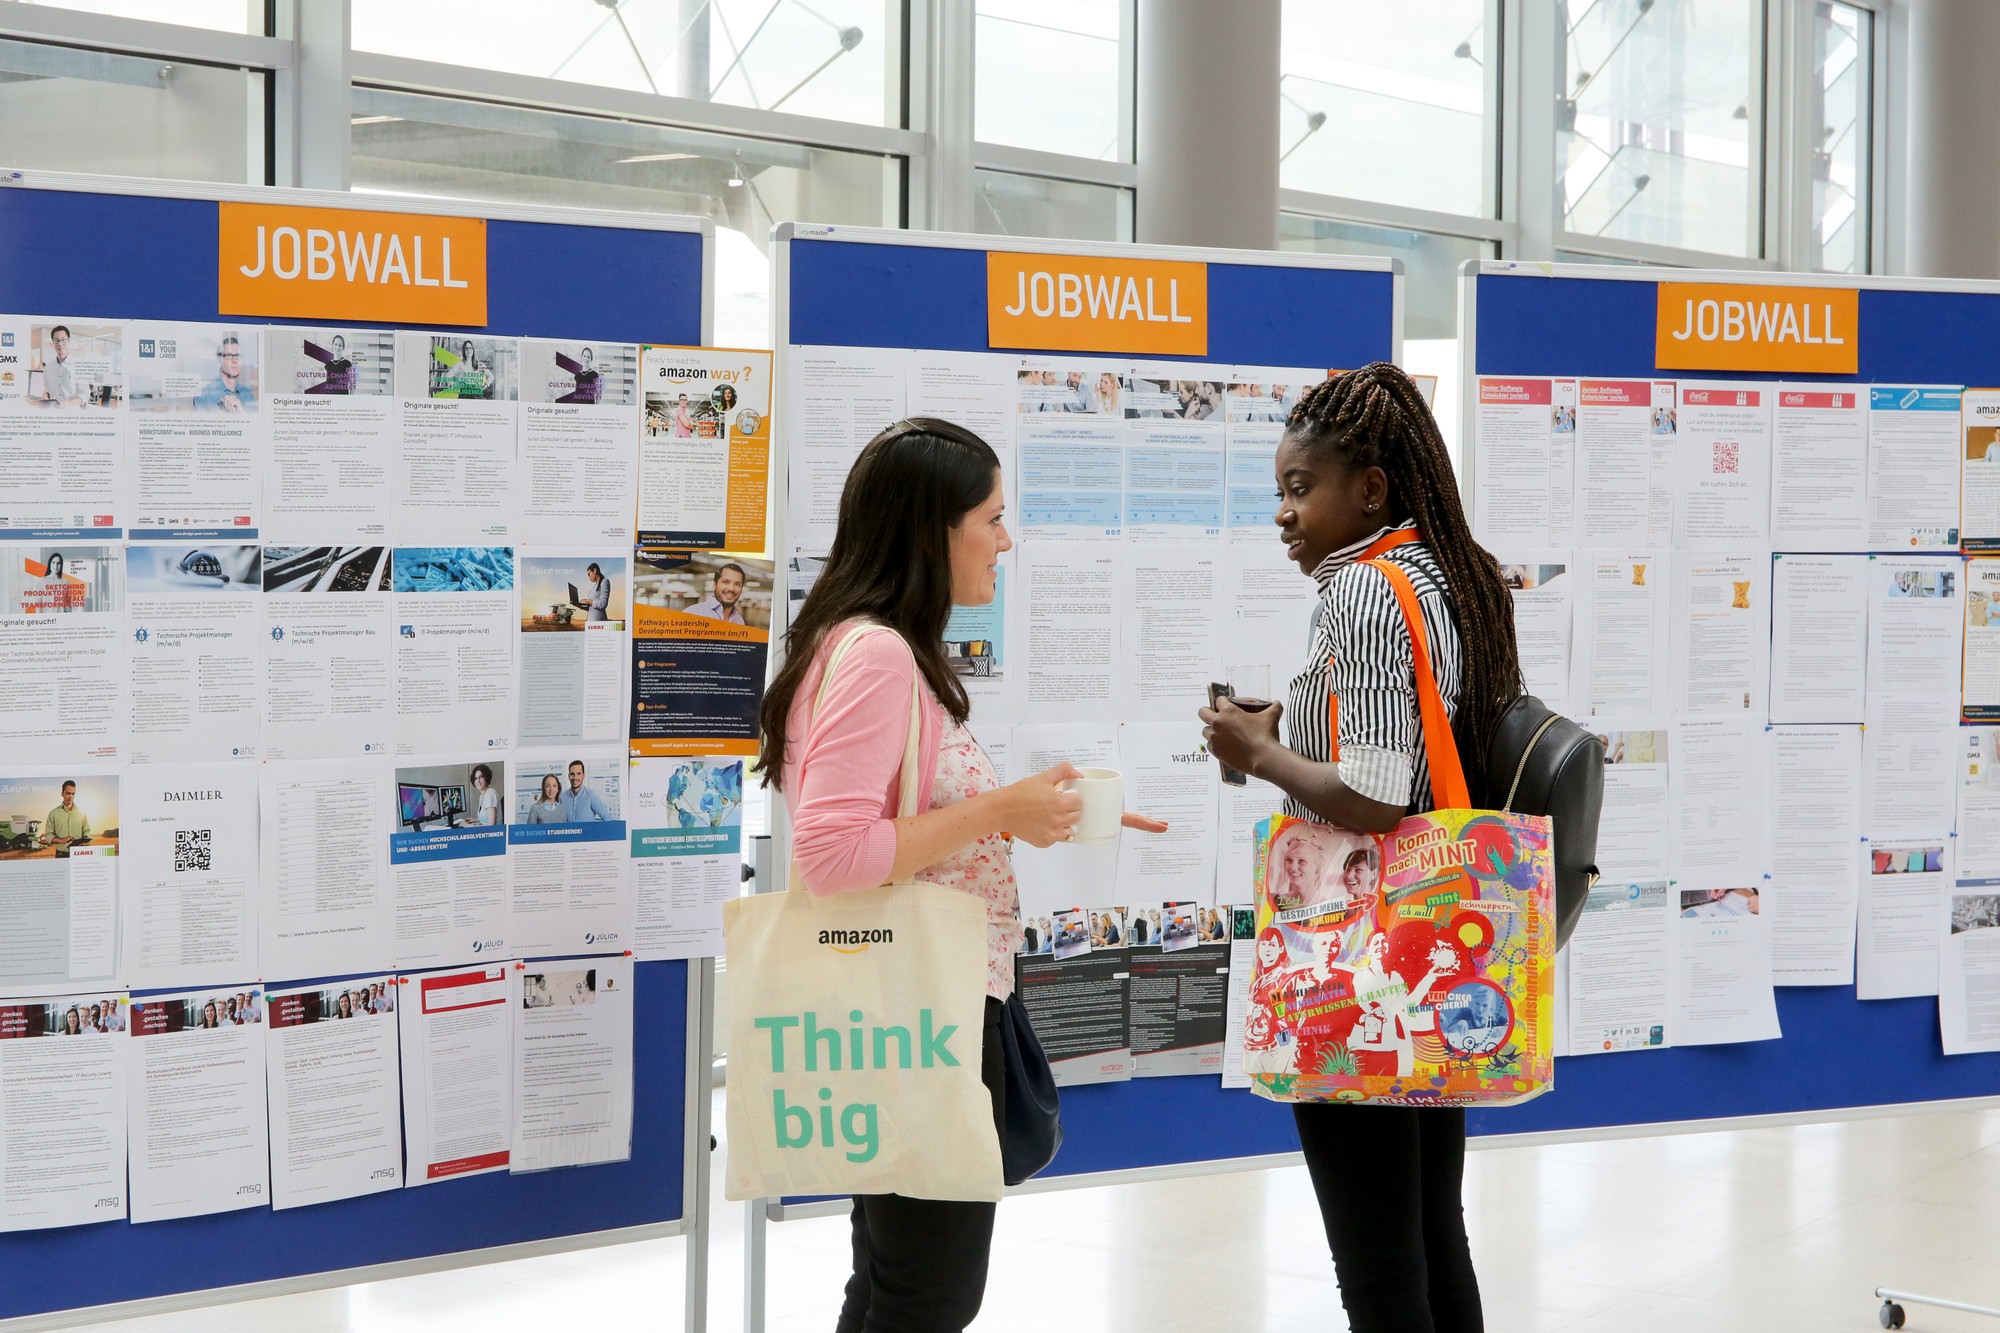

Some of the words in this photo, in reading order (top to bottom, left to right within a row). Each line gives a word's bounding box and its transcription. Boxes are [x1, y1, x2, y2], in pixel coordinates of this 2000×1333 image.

[240, 226, 467, 289] JOBWALL
[1005, 271, 1191, 322] JOBWALL
[1673, 299, 1844, 344] JOBWALL
[140, 344, 154, 353] 1&1
[659, 367, 707, 378] amazon
[710, 369, 740, 383] way
[273, 398, 302, 406] Originale
[404, 402, 432, 410] Originale
[27, 618, 56, 626] gesucht!
[189, 631, 233, 639] Projektmanager
[421, 628, 467, 636] IT-Projektmanager
[684, 629, 726, 637] Programme
[156, 640, 181, 648] (m/w/d)
[371, 742, 386, 751] ahc
[494, 737, 508, 746] ahc
[240, 746, 255, 755] ahc
[1172, 751, 1209, 764] wayfair
[2, 785, 30, 793] Zukunft
[164, 790, 223, 802] DAIMLER
[430, 832, 504, 842] HOCHSCHULABSOLVENTINNEN
[1397, 826, 1448, 855] komm
[1388, 854, 1417, 875] mach
[1420, 840, 1476, 870] MINT
[1388, 873, 1460, 902] www.komm-mach-mint.de
[1427, 892, 1460, 906] mint
[1280, 906, 1318, 921] GESTALTE
[1319, 900, 1344, 914] MEINE
[1398, 906, 1412, 917] ich
[1414, 906, 1433, 918] will
[1460, 901, 1519, 912] schnuppern...
[1526, 891, 1539, 934] frauen
[1308, 912, 1345, 928] ZUKUNFT
[596, 933, 618, 941] JÜLICH
[818, 928, 893, 944] amazon
[1270, 982, 1346, 1004] MATHEMATIK
[1275, 988, 1348, 1018] INFORMATIK
[1408, 1000, 1470, 1014] HERRSCHERIN
[1526, 958, 1539, 1058] zukunftsberufe
[1278, 1024, 1332, 1044] TECHNIK
[754, 1008, 961, 1073] Think
[773, 1087, 880, 1163] big
[370, 1167, 395, 1179] .msg
[237, 1184, 262, 1195] .msg
[95, 1196, 119, 1208] .msg
